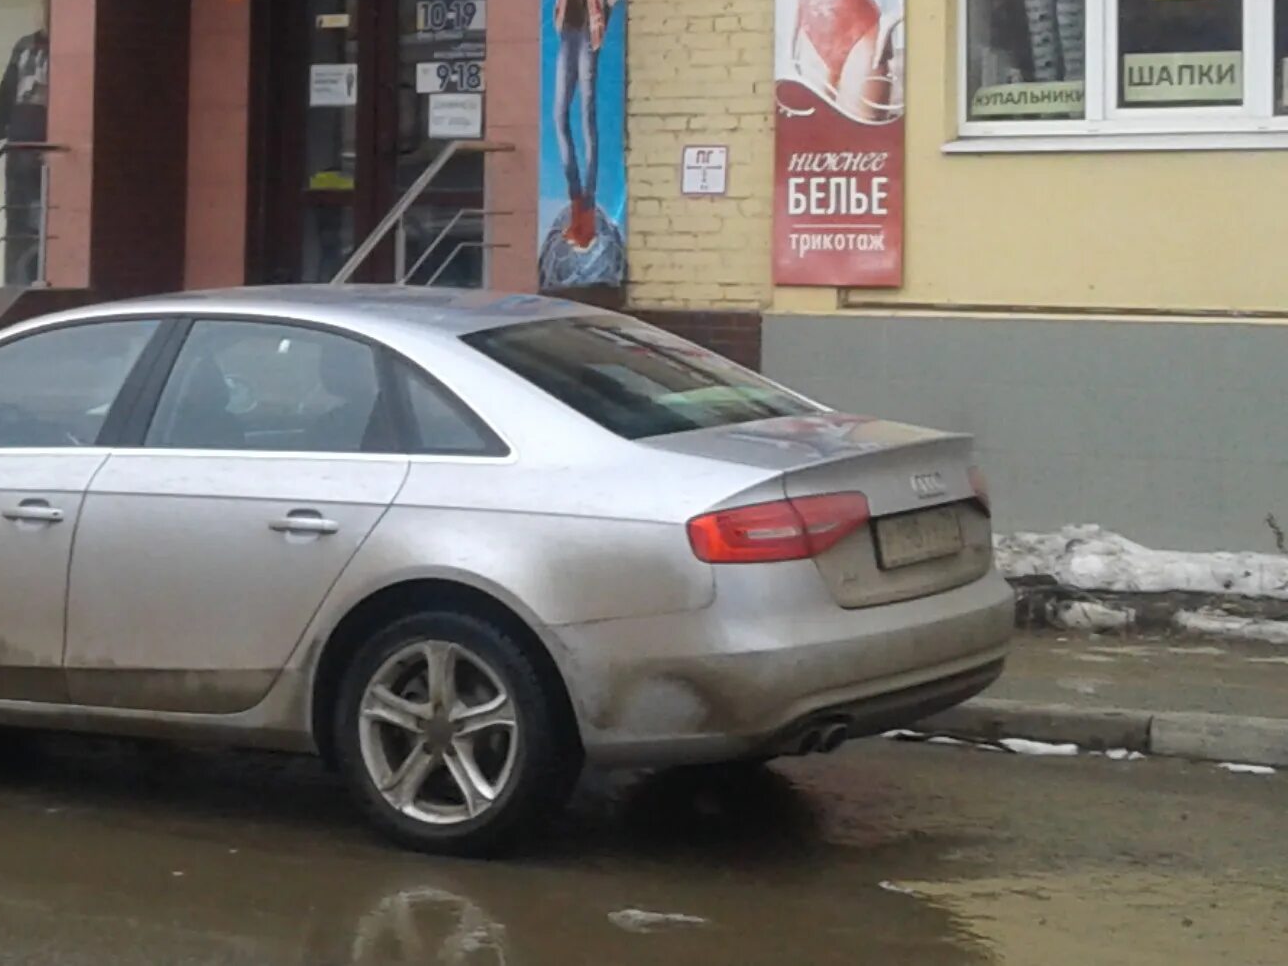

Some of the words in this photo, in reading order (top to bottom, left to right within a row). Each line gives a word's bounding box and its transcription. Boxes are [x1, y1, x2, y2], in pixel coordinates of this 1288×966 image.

[1128, 64, 1236, 87] ШАПКИ
[787, 151, 888, 173] нижнее
[787, 177, 888, 215] БЕЛЬЕ
[789, 233, 885, 258] трикотаж
